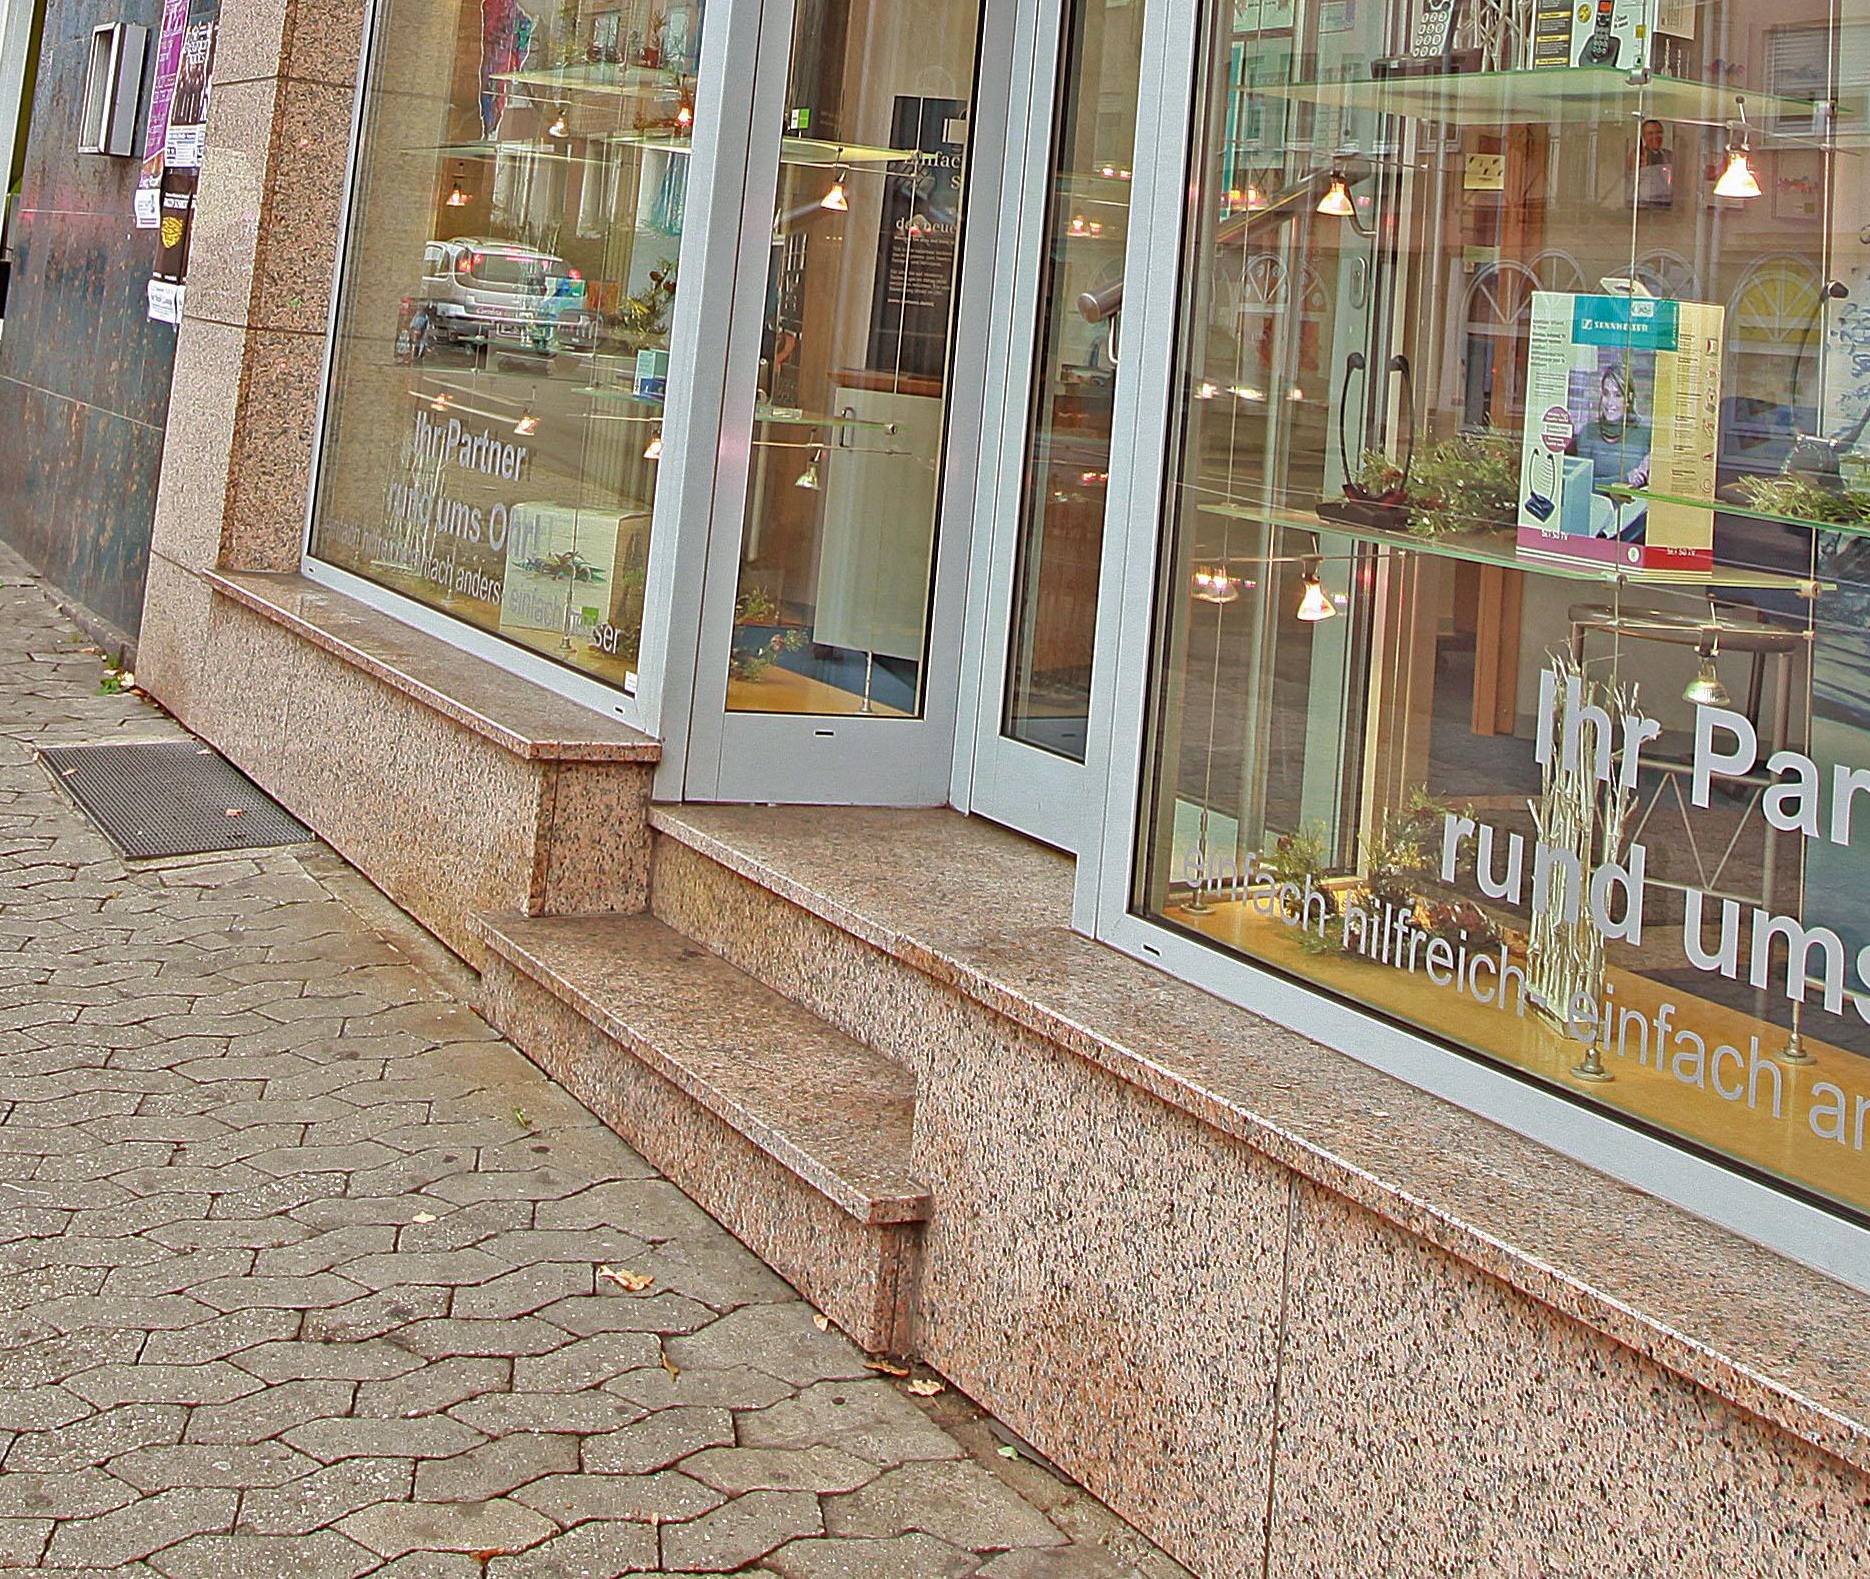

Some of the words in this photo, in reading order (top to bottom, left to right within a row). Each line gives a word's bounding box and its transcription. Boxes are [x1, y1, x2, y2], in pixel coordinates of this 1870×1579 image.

[445, 418, 527, 481] Partner
[1536, 667, 1659, 786] Ihr
[1441, 811, 1646, 946] rund
[1568, 977, 1783, 1121] einfach
